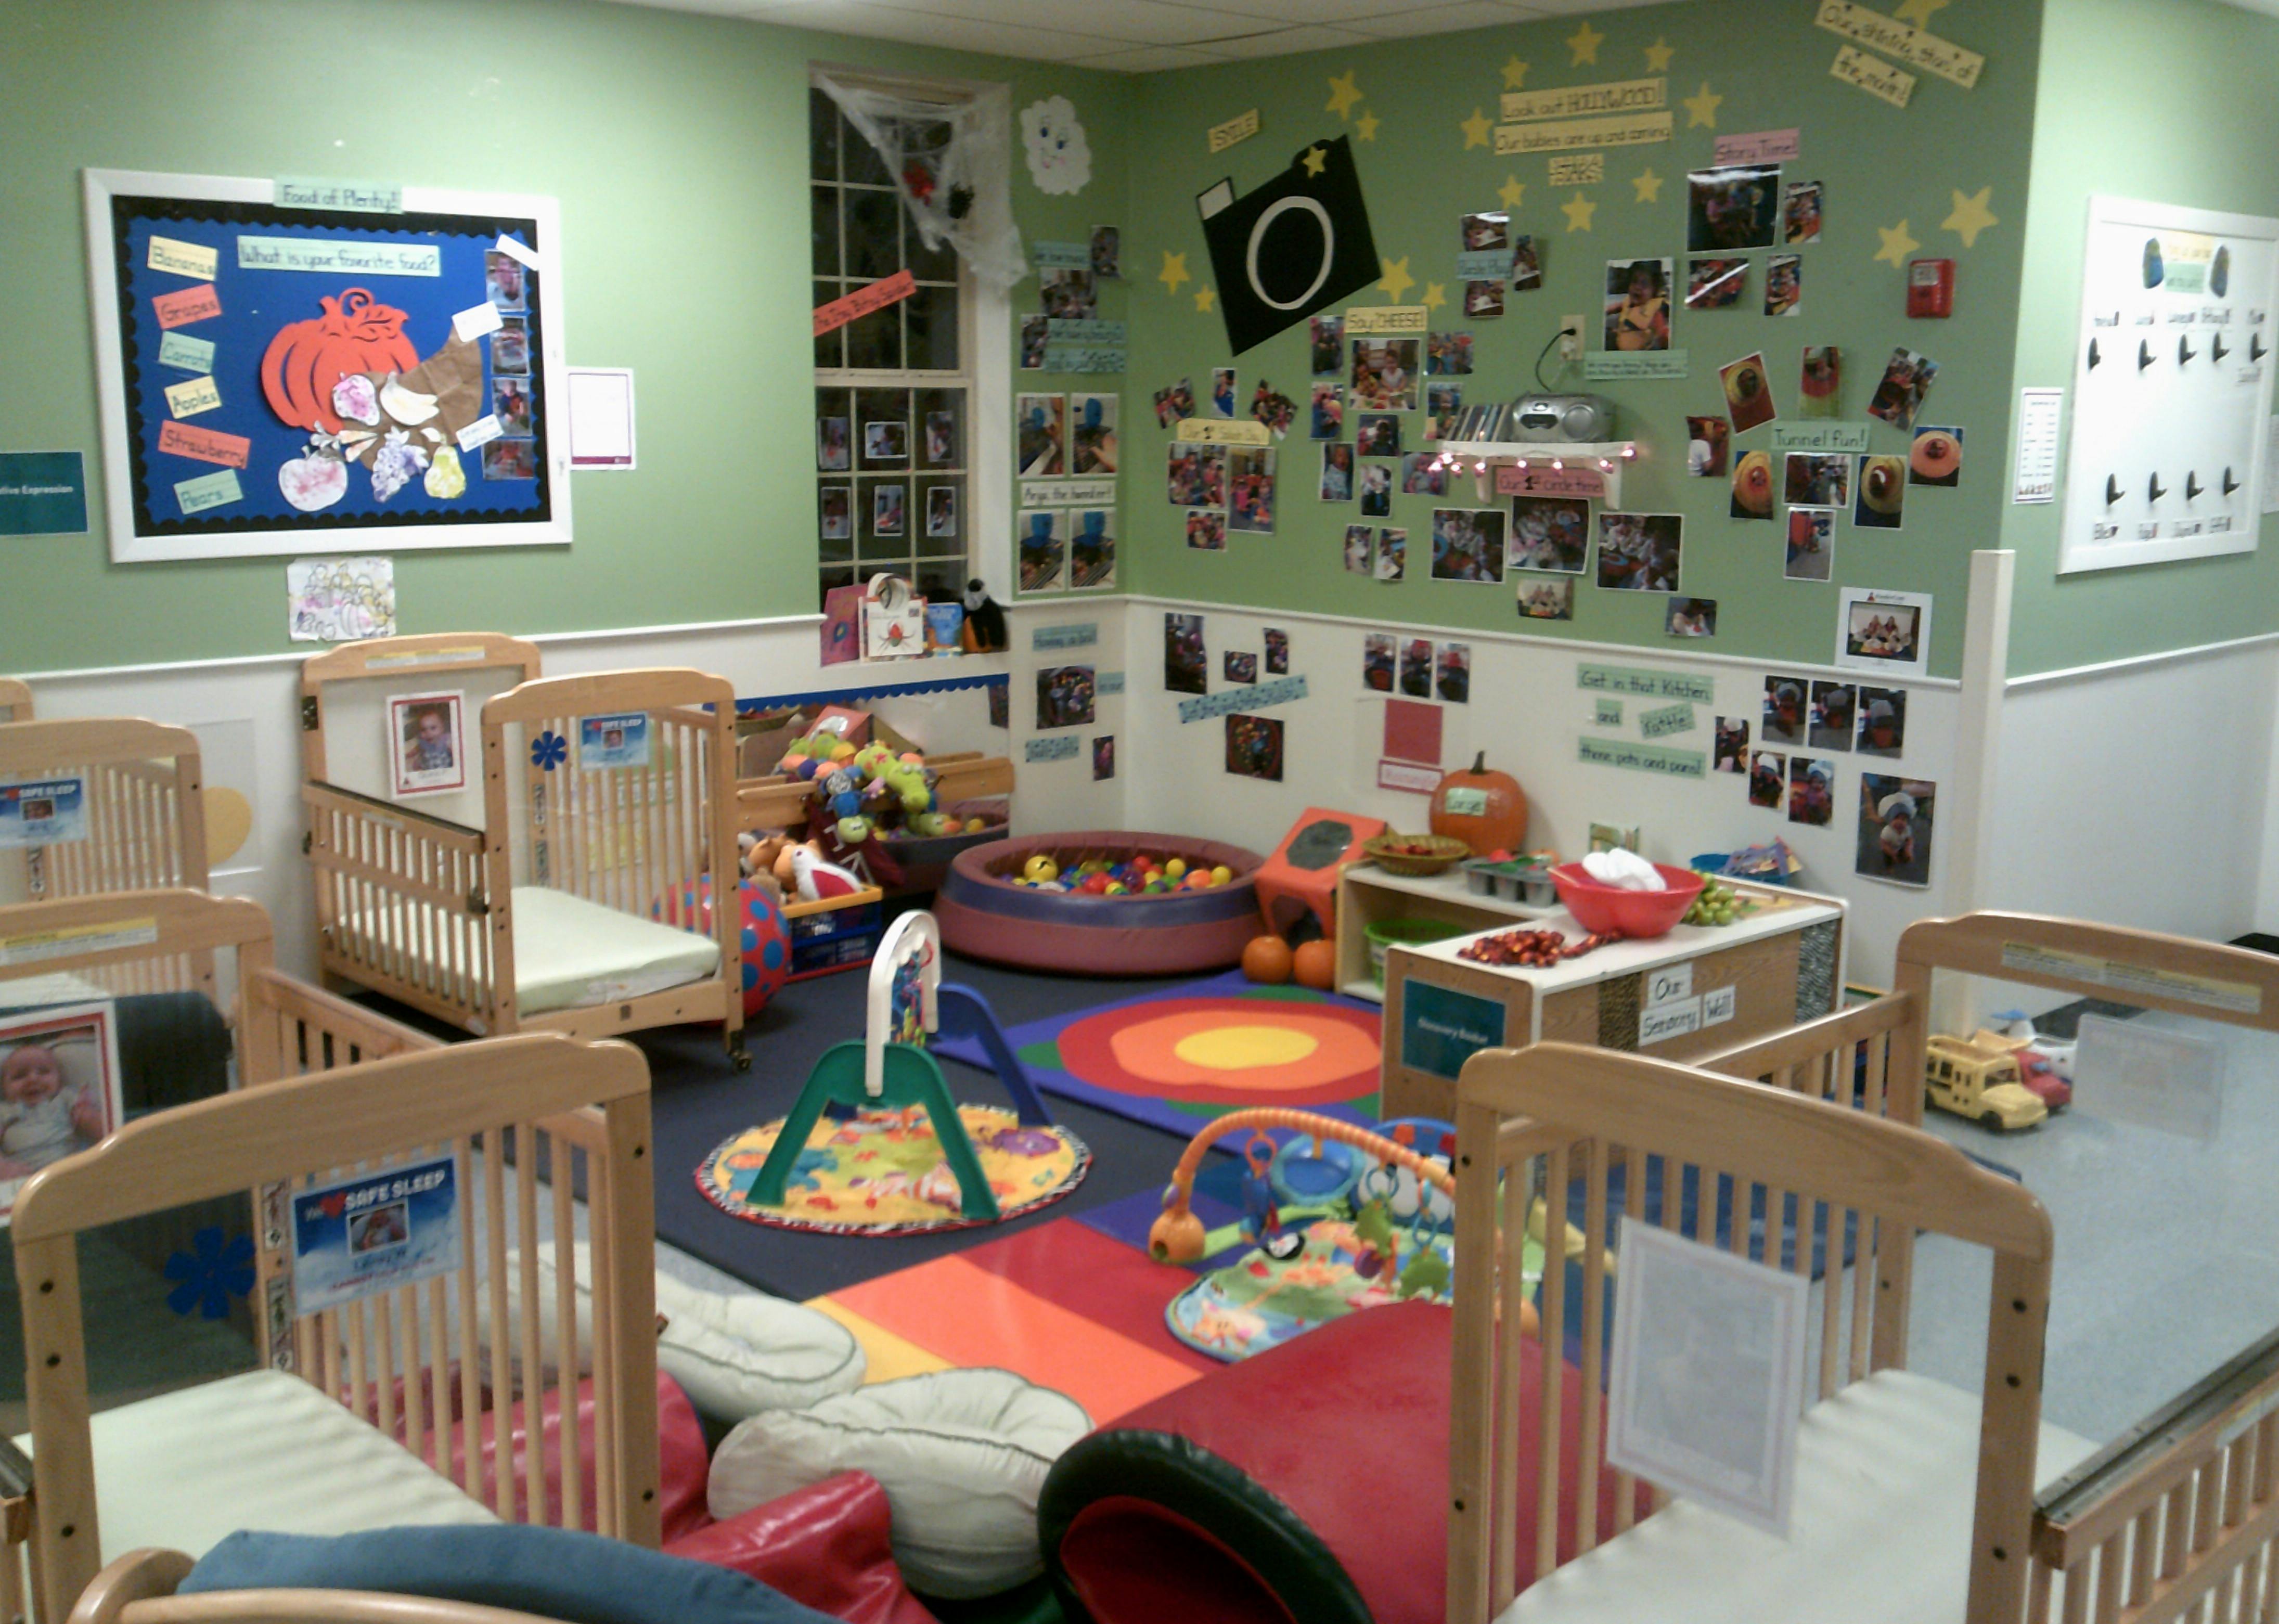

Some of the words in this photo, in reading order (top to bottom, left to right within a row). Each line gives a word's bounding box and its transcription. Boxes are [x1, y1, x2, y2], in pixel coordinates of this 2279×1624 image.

[1539, 95, 1563, 114] out
[1497, 135, 1522, 151] Our
[1523, 132, 1560, 148] babies
[1606, 130, 1626, 143] and
[1717, 143, 1756, 163] Story
[283, 185, 318, 204] Food
[323, 188, 337, 205] of
[152, 245, 214, 275] Bananas
[242, 245, 280, 263] What
[288, 252, 300, 265] is
[303, 254, 335, 269] your
[338, 249, 394, 268] favorite
[400, 252, 435, 271] food?
[161, 300, 216, 321] Grapes
[1348, 313, 1372, 332] Say
[172, 389, 216, 413] Apples
[1775, 428, 1827, 446] Tunnel
[1833, 428, 1865, 446] fun!
[164, 429, 246, 468] Strawberry
[22, 485, 73, 495] Expression
[1500, 474, 1521, 489] Our
[182, 490, 224, 508] Pears
[1581, 670, 1606, 688] Get
[1614, 677, 1625, 690] in
[1630, 676, 1656, 693] that
[1598, 712, 1620, 724] and
[1643, 713, 1686, 734] rattle
[1616, 753, 1639, 767] pots
[1643, 758, 1666, 770] and
[1669, 758, 1701, 775] pans!
[1655, 977, 1683, 1001] Our
[1642, 1011, 1697, 1037] Sensory
[344, 1182, 390, 1211] SAFE
[392, 1169, 445, 1198] SLEEP
